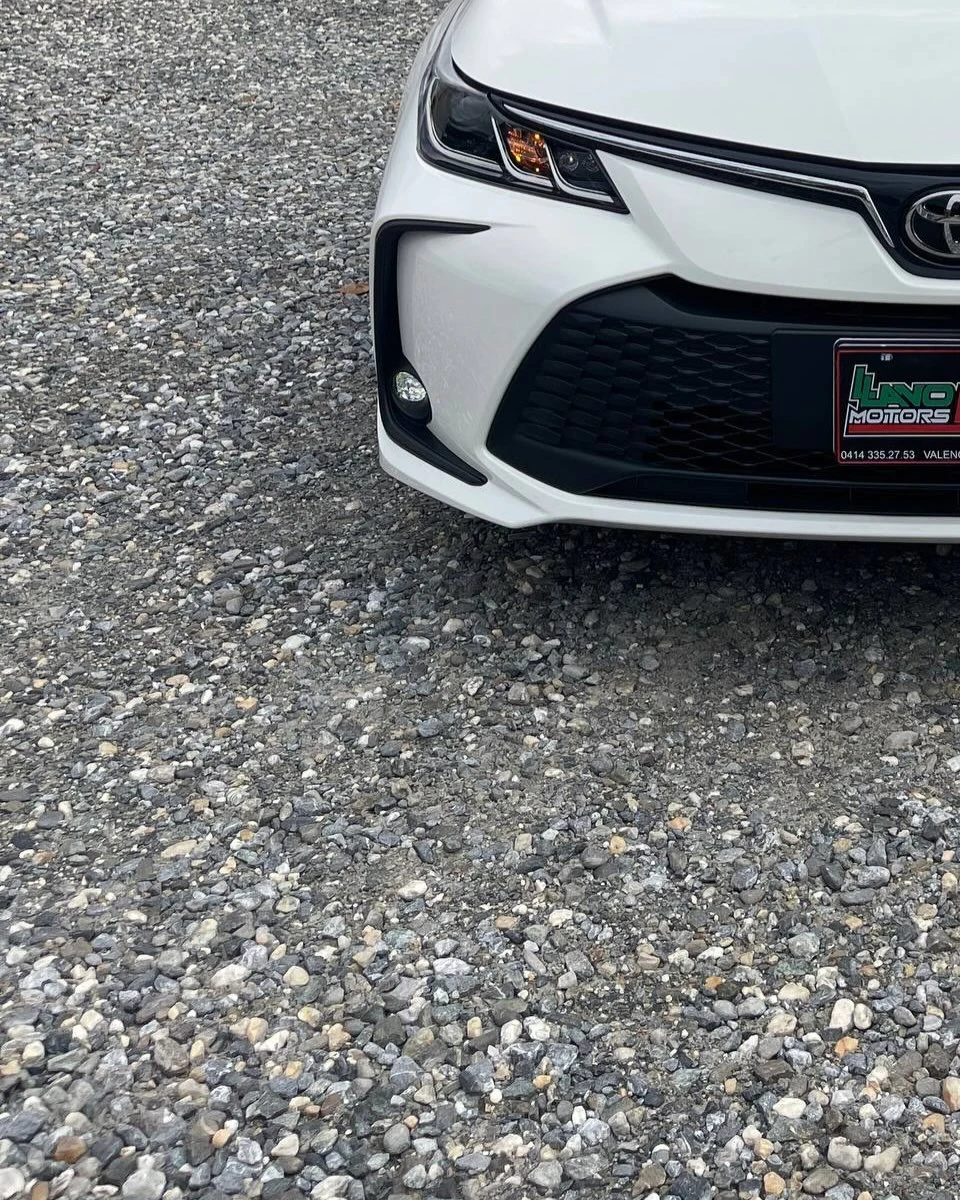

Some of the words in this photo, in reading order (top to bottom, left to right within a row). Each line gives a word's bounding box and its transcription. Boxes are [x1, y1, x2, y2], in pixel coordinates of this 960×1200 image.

[850, 364, 955, 408] LLANO
[849, 406, 951, 424] MOTORS
[840, 449, 864, 460] 0414
[867, 449, 915, 460] 335.27.53
